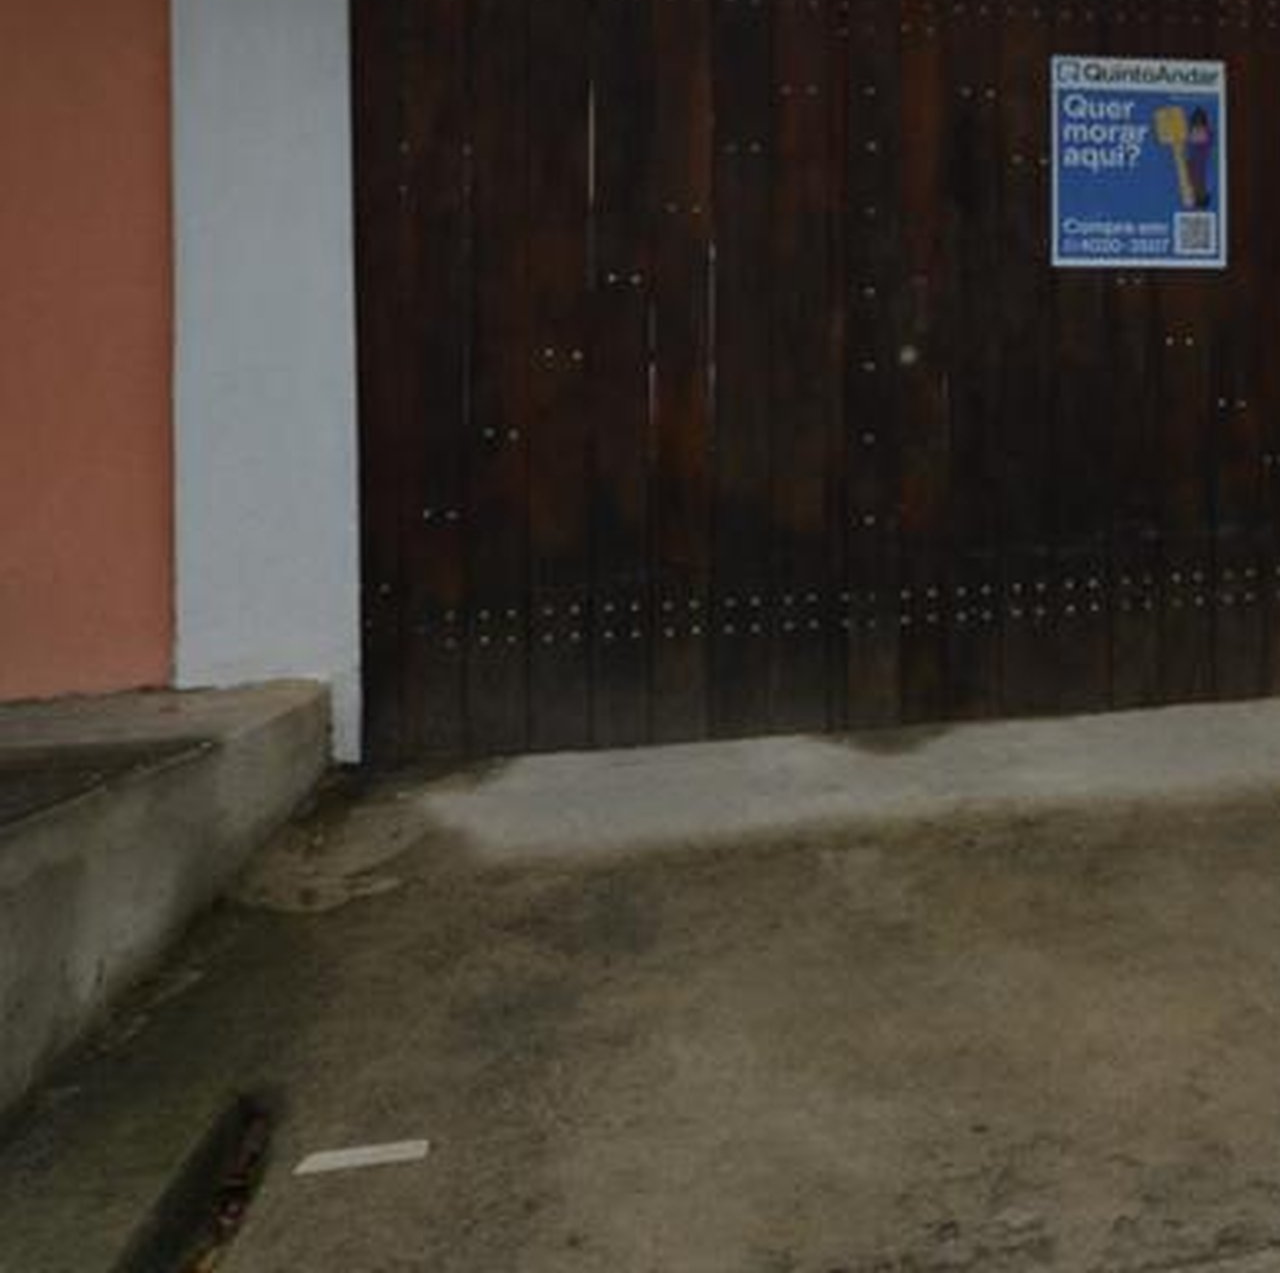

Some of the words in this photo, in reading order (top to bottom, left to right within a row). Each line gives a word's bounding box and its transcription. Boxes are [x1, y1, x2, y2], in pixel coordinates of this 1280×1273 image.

[1083, 63, 1218, 85] QuintoAndar
[1063, 94, 1135, 119] Quer
[1063, 123, 1148, 143] morar
[1063, 144, 1141, 173] aqui?
